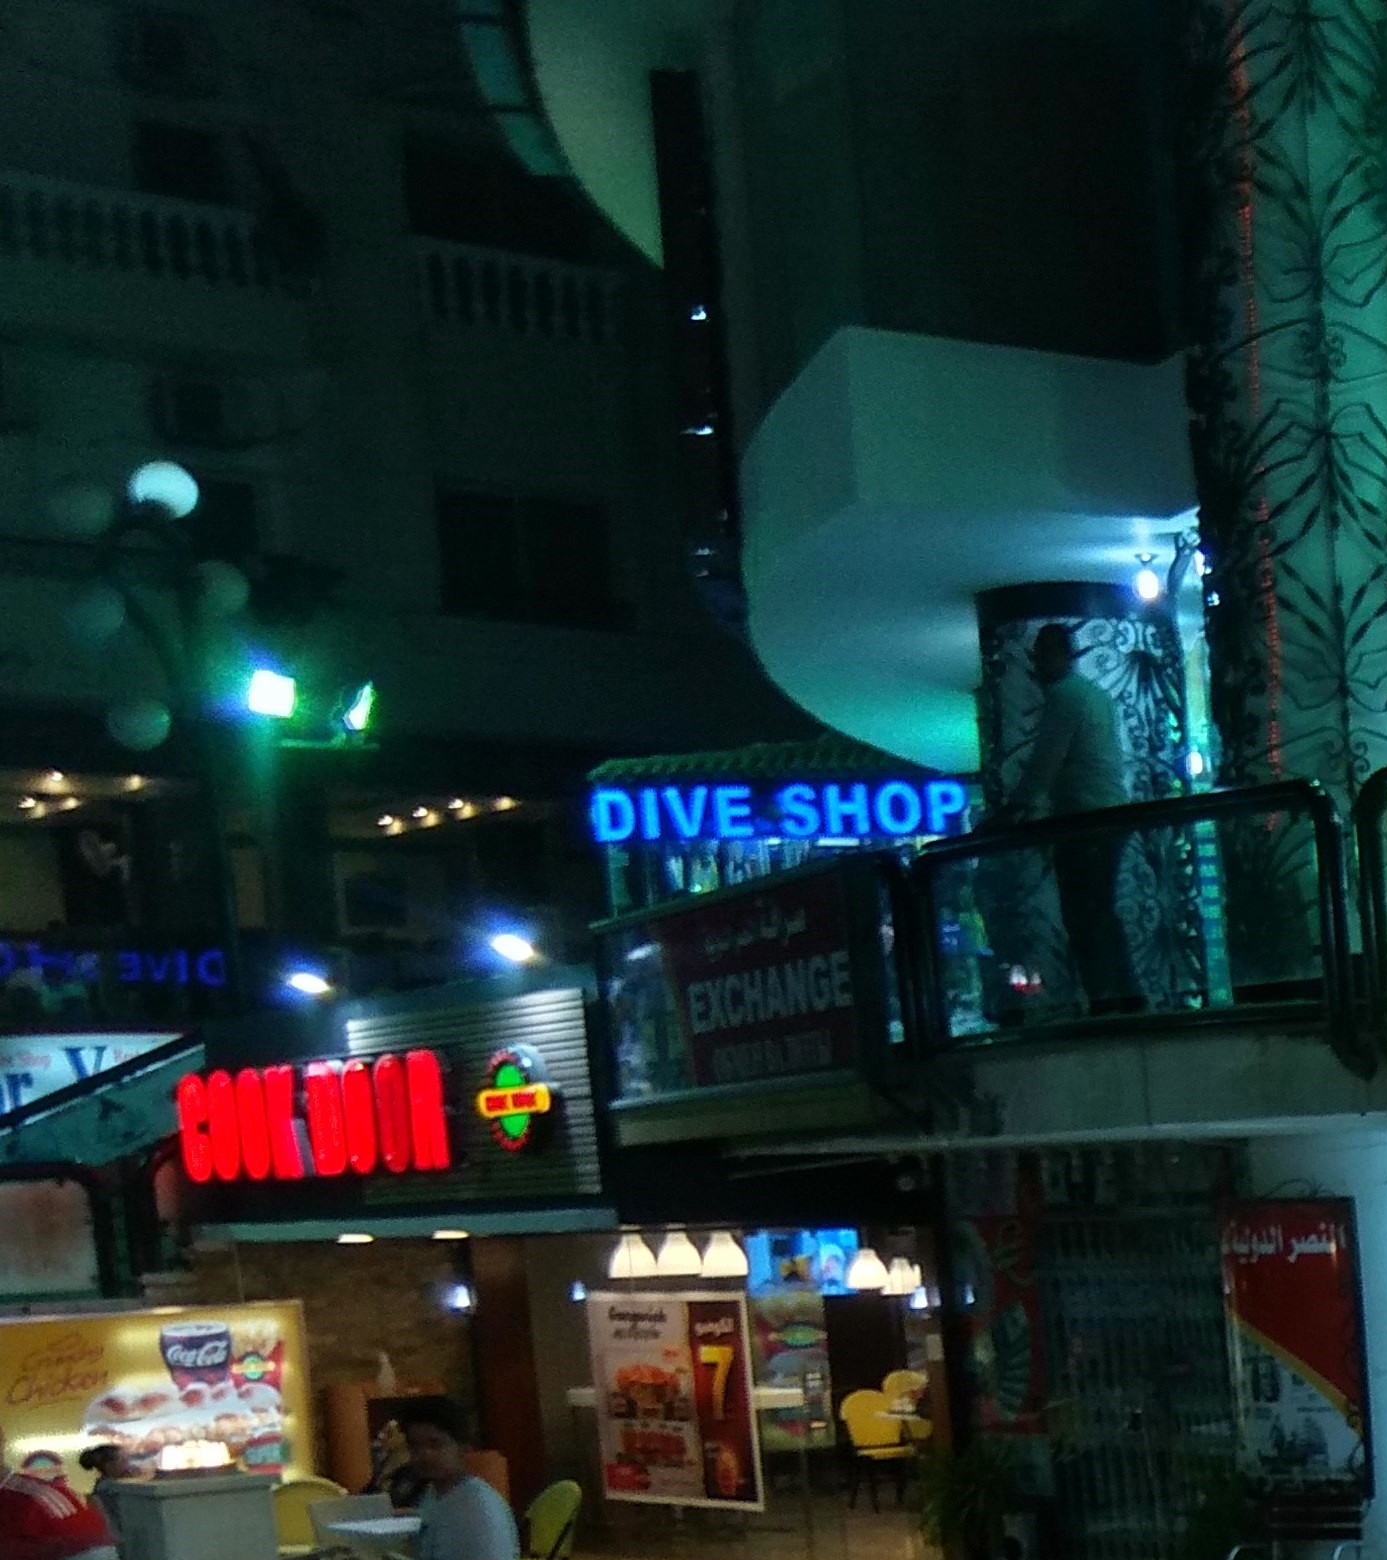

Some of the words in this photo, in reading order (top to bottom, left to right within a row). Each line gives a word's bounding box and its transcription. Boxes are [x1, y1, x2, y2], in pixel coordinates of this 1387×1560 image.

[590, 786, 755, 842] DIVE
[777, 780, 966, 837] SHOP
[688, 951, 852, 1034] EXCHANGE
[700, 1345, 734, 1421] 7
